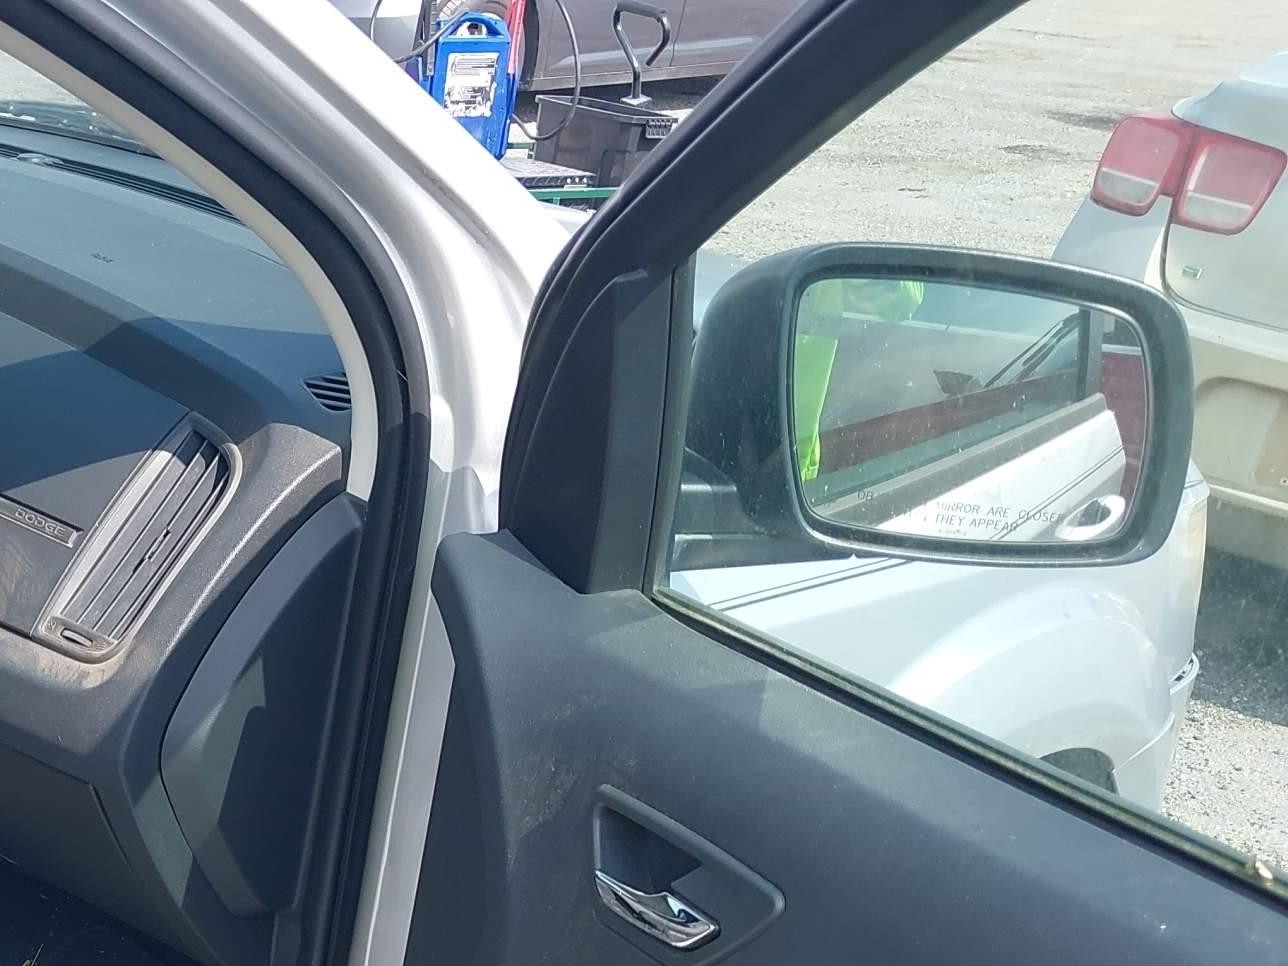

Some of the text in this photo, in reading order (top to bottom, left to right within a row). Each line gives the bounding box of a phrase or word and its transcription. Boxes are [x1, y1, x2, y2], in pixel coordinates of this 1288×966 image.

[15, 508, 66, 536] DODGE
[935, 514, 966, 526] THEY
[968, 517, 1018, 532] APPEAR
[936, 501, 981, 515] MIRROR
[986, 505, 1011, 519] ARE
[1018, 509, 1066, 524] CLOSER
